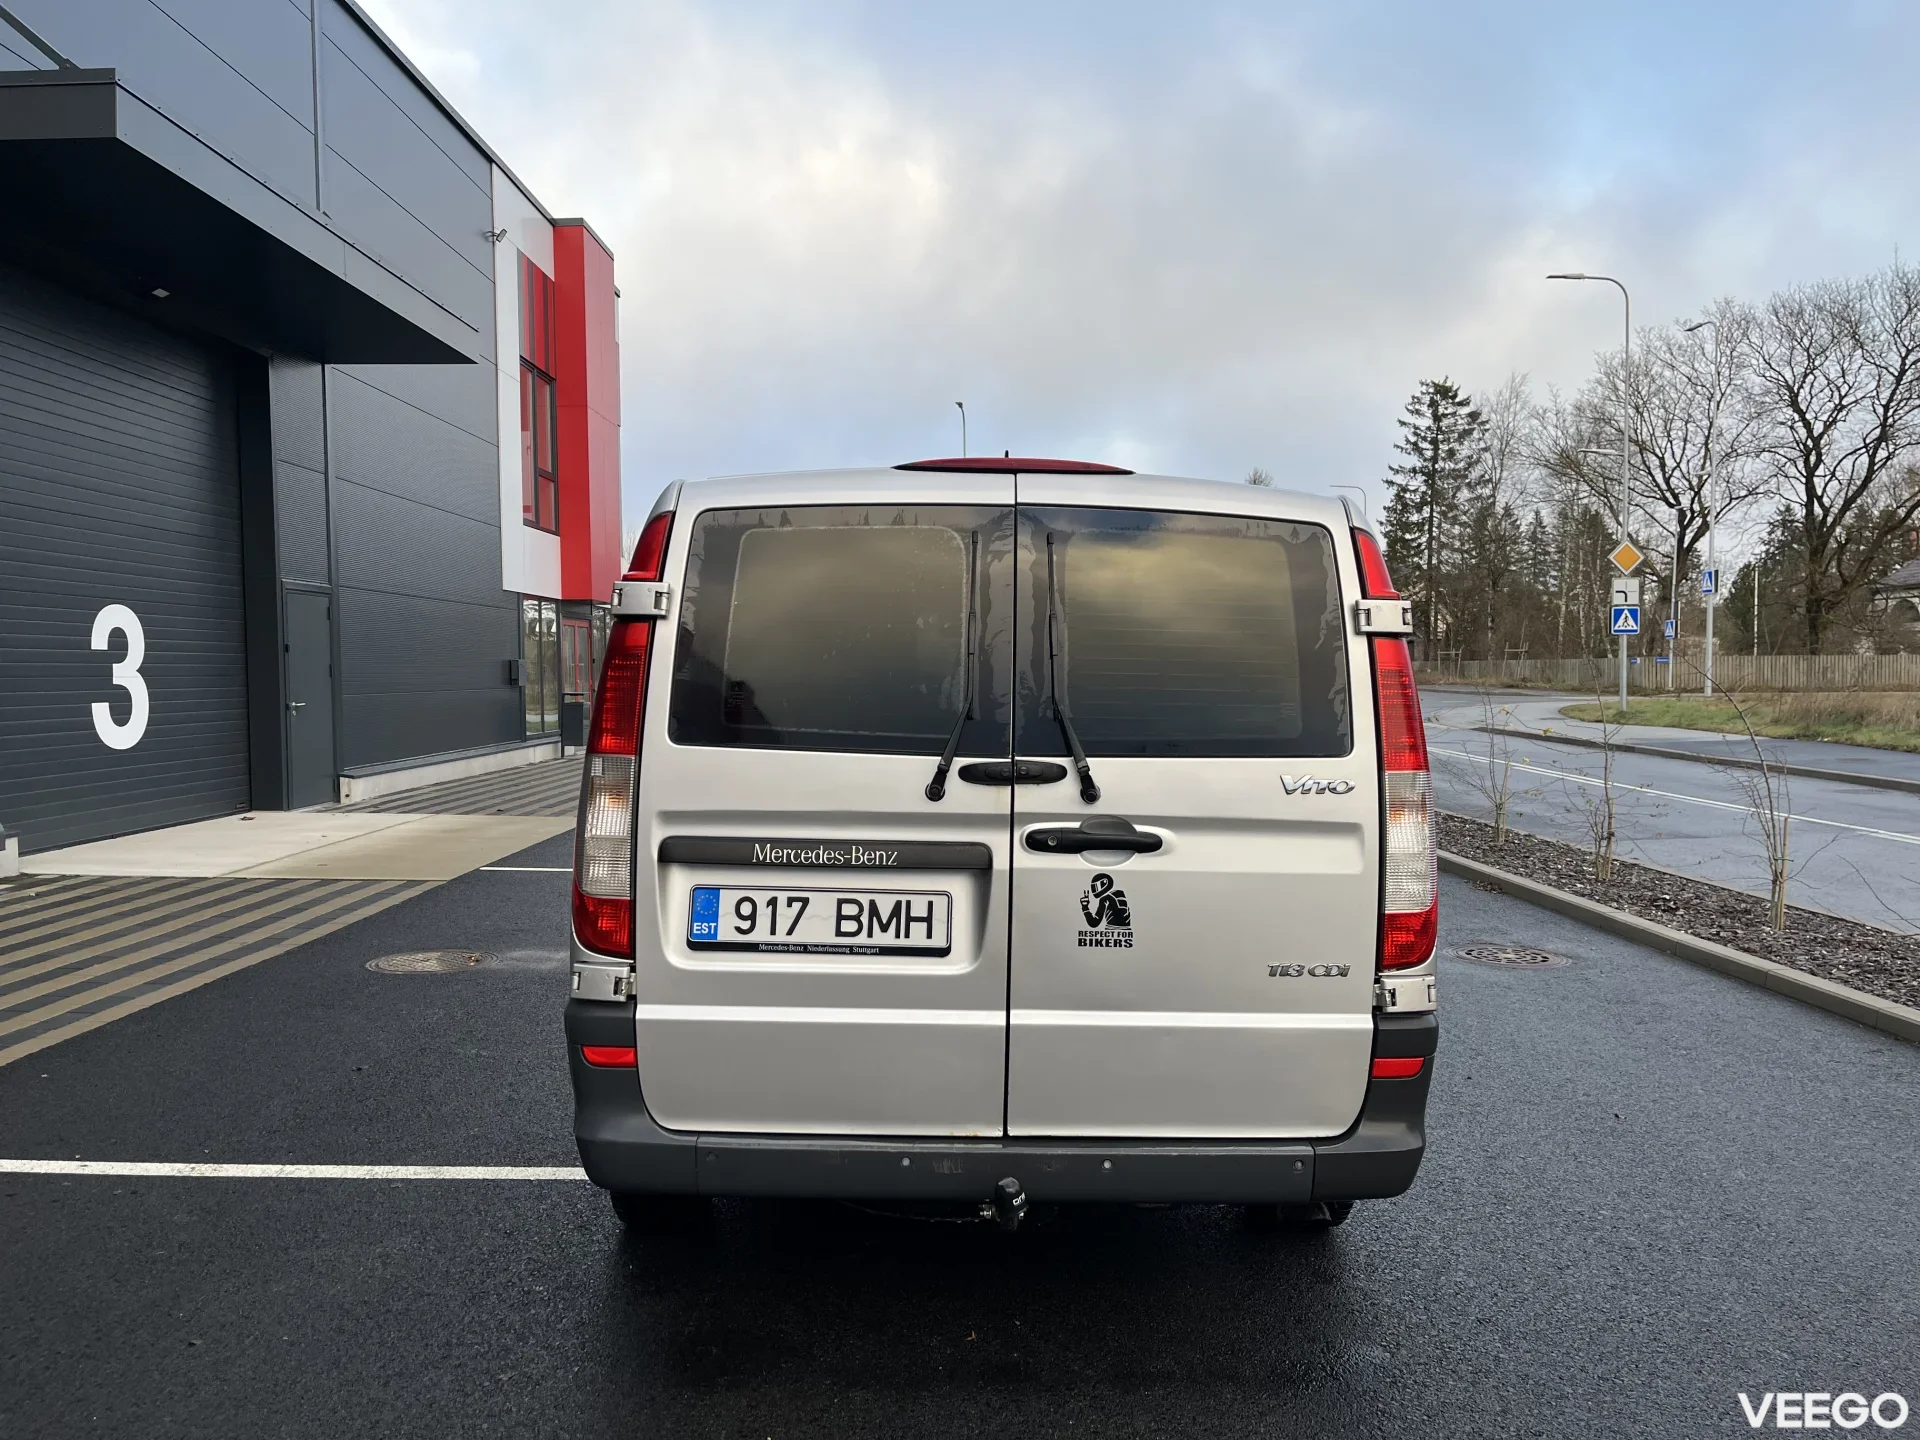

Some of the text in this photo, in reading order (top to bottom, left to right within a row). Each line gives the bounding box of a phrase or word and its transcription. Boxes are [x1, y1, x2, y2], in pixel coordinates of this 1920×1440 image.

[91, 604, 149, 750] 3
[752, 843, 898, 866] Mercedes-Benz
[733, 896, 934, 940] 917 BMH
[693, 922, 717, 935] EST
[1078, 930, 1133, 939] RESPECT FOR
[758, 943, 879, 955] Mercedes-Benz Niederlassung Stuttgart
[1077, 938, 1134, 949] BIKERS
